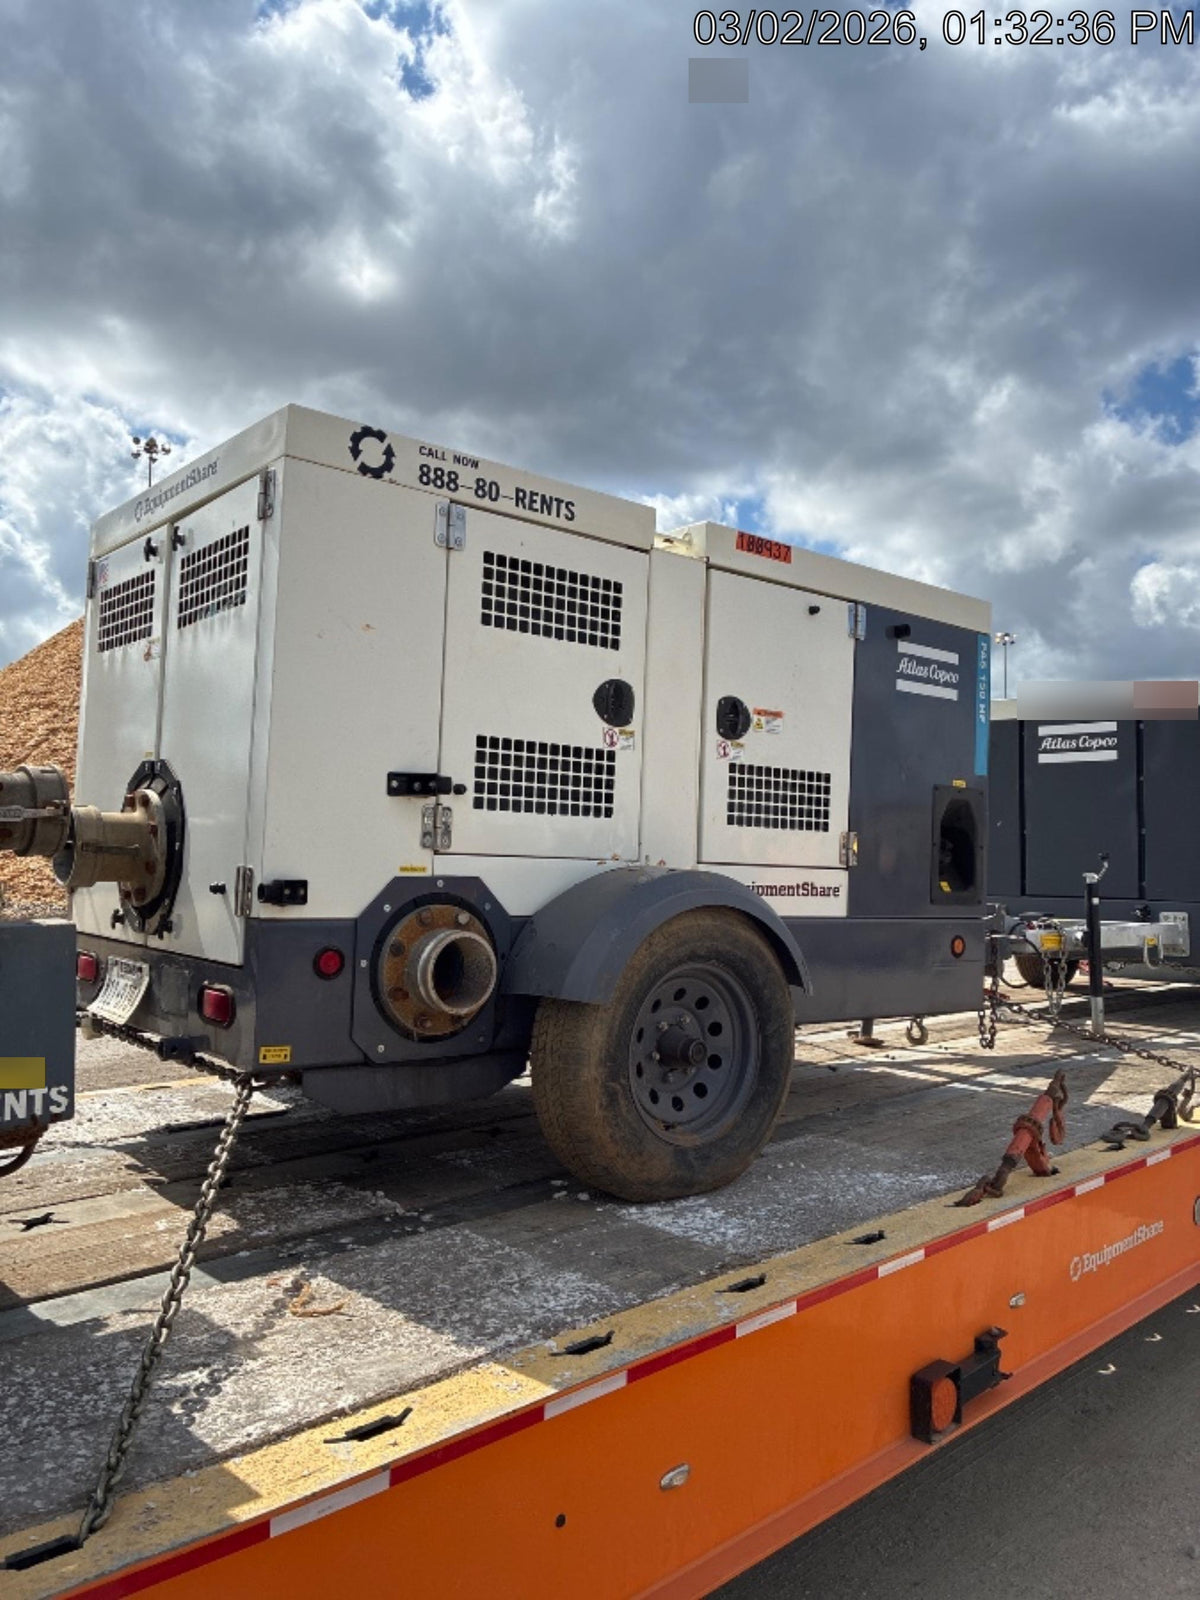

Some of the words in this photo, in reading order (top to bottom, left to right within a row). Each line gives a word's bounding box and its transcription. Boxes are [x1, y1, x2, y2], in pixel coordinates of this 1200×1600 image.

[418, 445, 447, 461] CALL
[453, 454, 479, 470] NOW
[143, 460, 219, 515] EquipmentShare
[418, 463, 576, 521] 888-80-RENTS
[896, 657, 929, 678] Atlas
[930, 664, 959, 684] Copco
[1040, 737, 1077, 750] Atlas
[1078, 735, 1118, 750] Copco
[746, 881, 840, 897] ipmentShare
[0, 1085, 69, 1121] NTS
[1082, 1220, 1164, 1274] EquipmentShare
